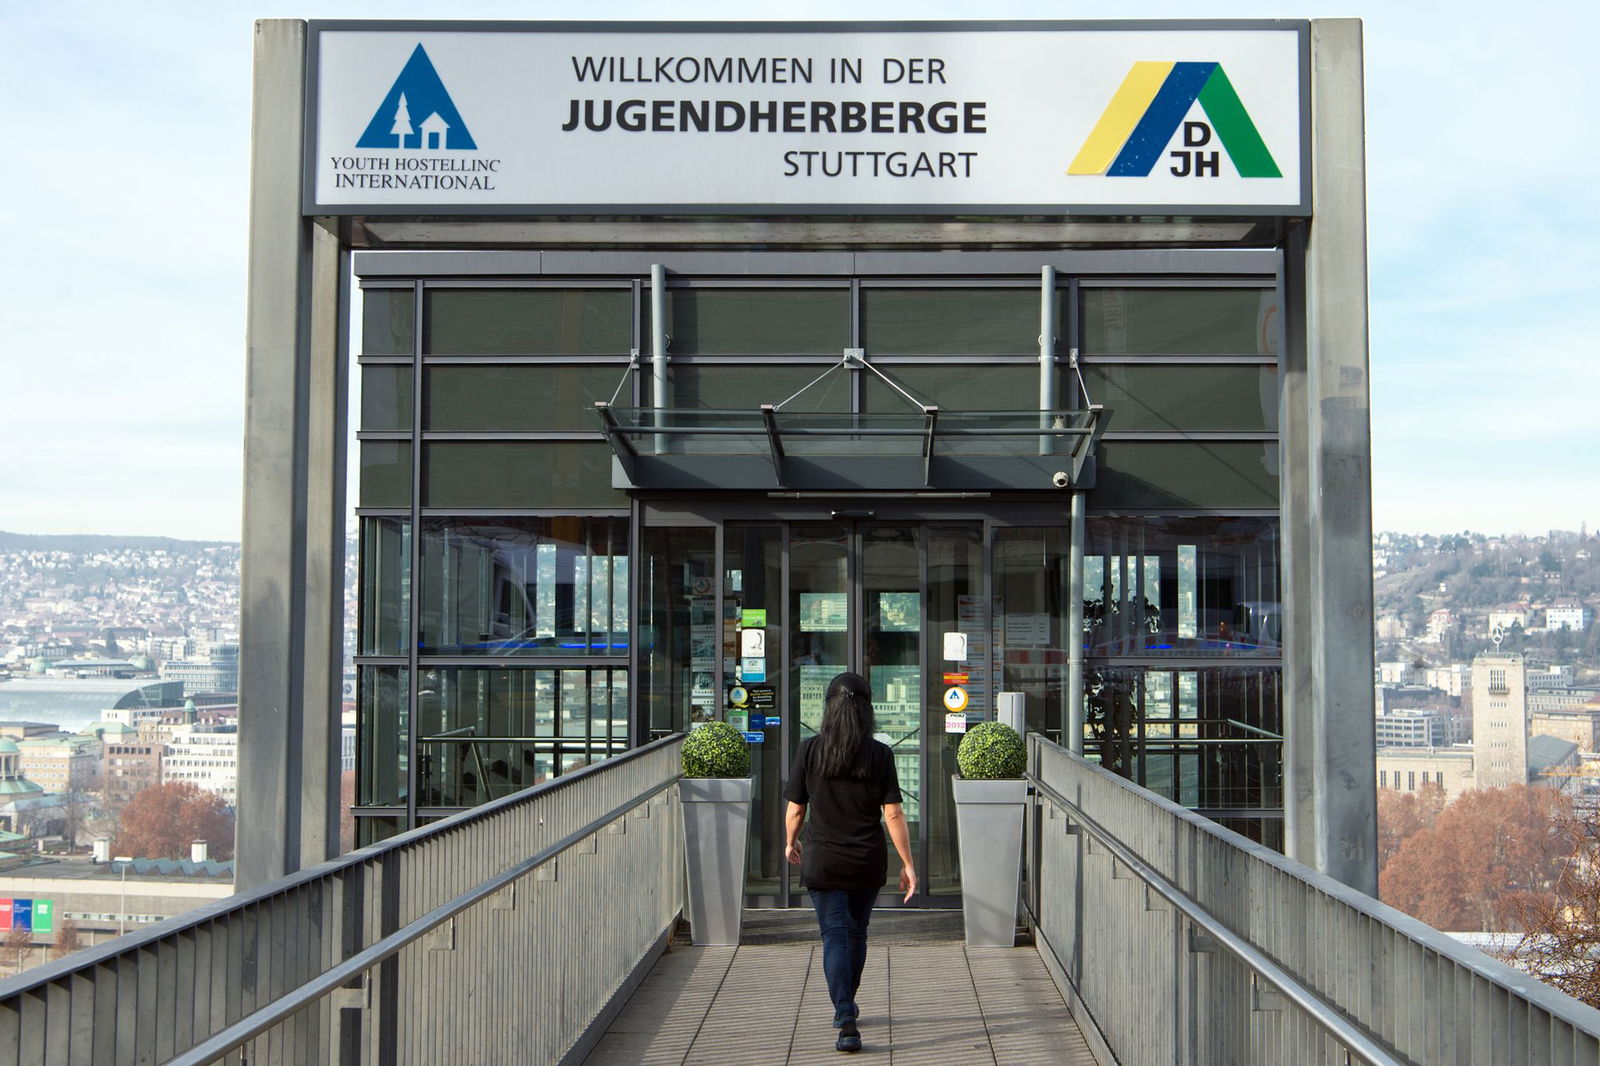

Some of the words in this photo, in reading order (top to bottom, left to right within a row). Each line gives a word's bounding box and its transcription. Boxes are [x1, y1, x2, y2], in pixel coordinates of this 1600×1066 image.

[571, 56, 812, 84] WILLKOMMEN
[831, 57, 862, 84] IN
[883, 58, 947, 84] DER
[562, 99, 987, 134] JUGENDHERBERGE
[1184, 121, 1211, 147] D
[330, 156, 390, 171] YOUTH
[783, 150, 978, 178] STUTTGART
[1170, 151, 1219, 178] JH
[335, 173, 496, 191] INTERNATIONAL
